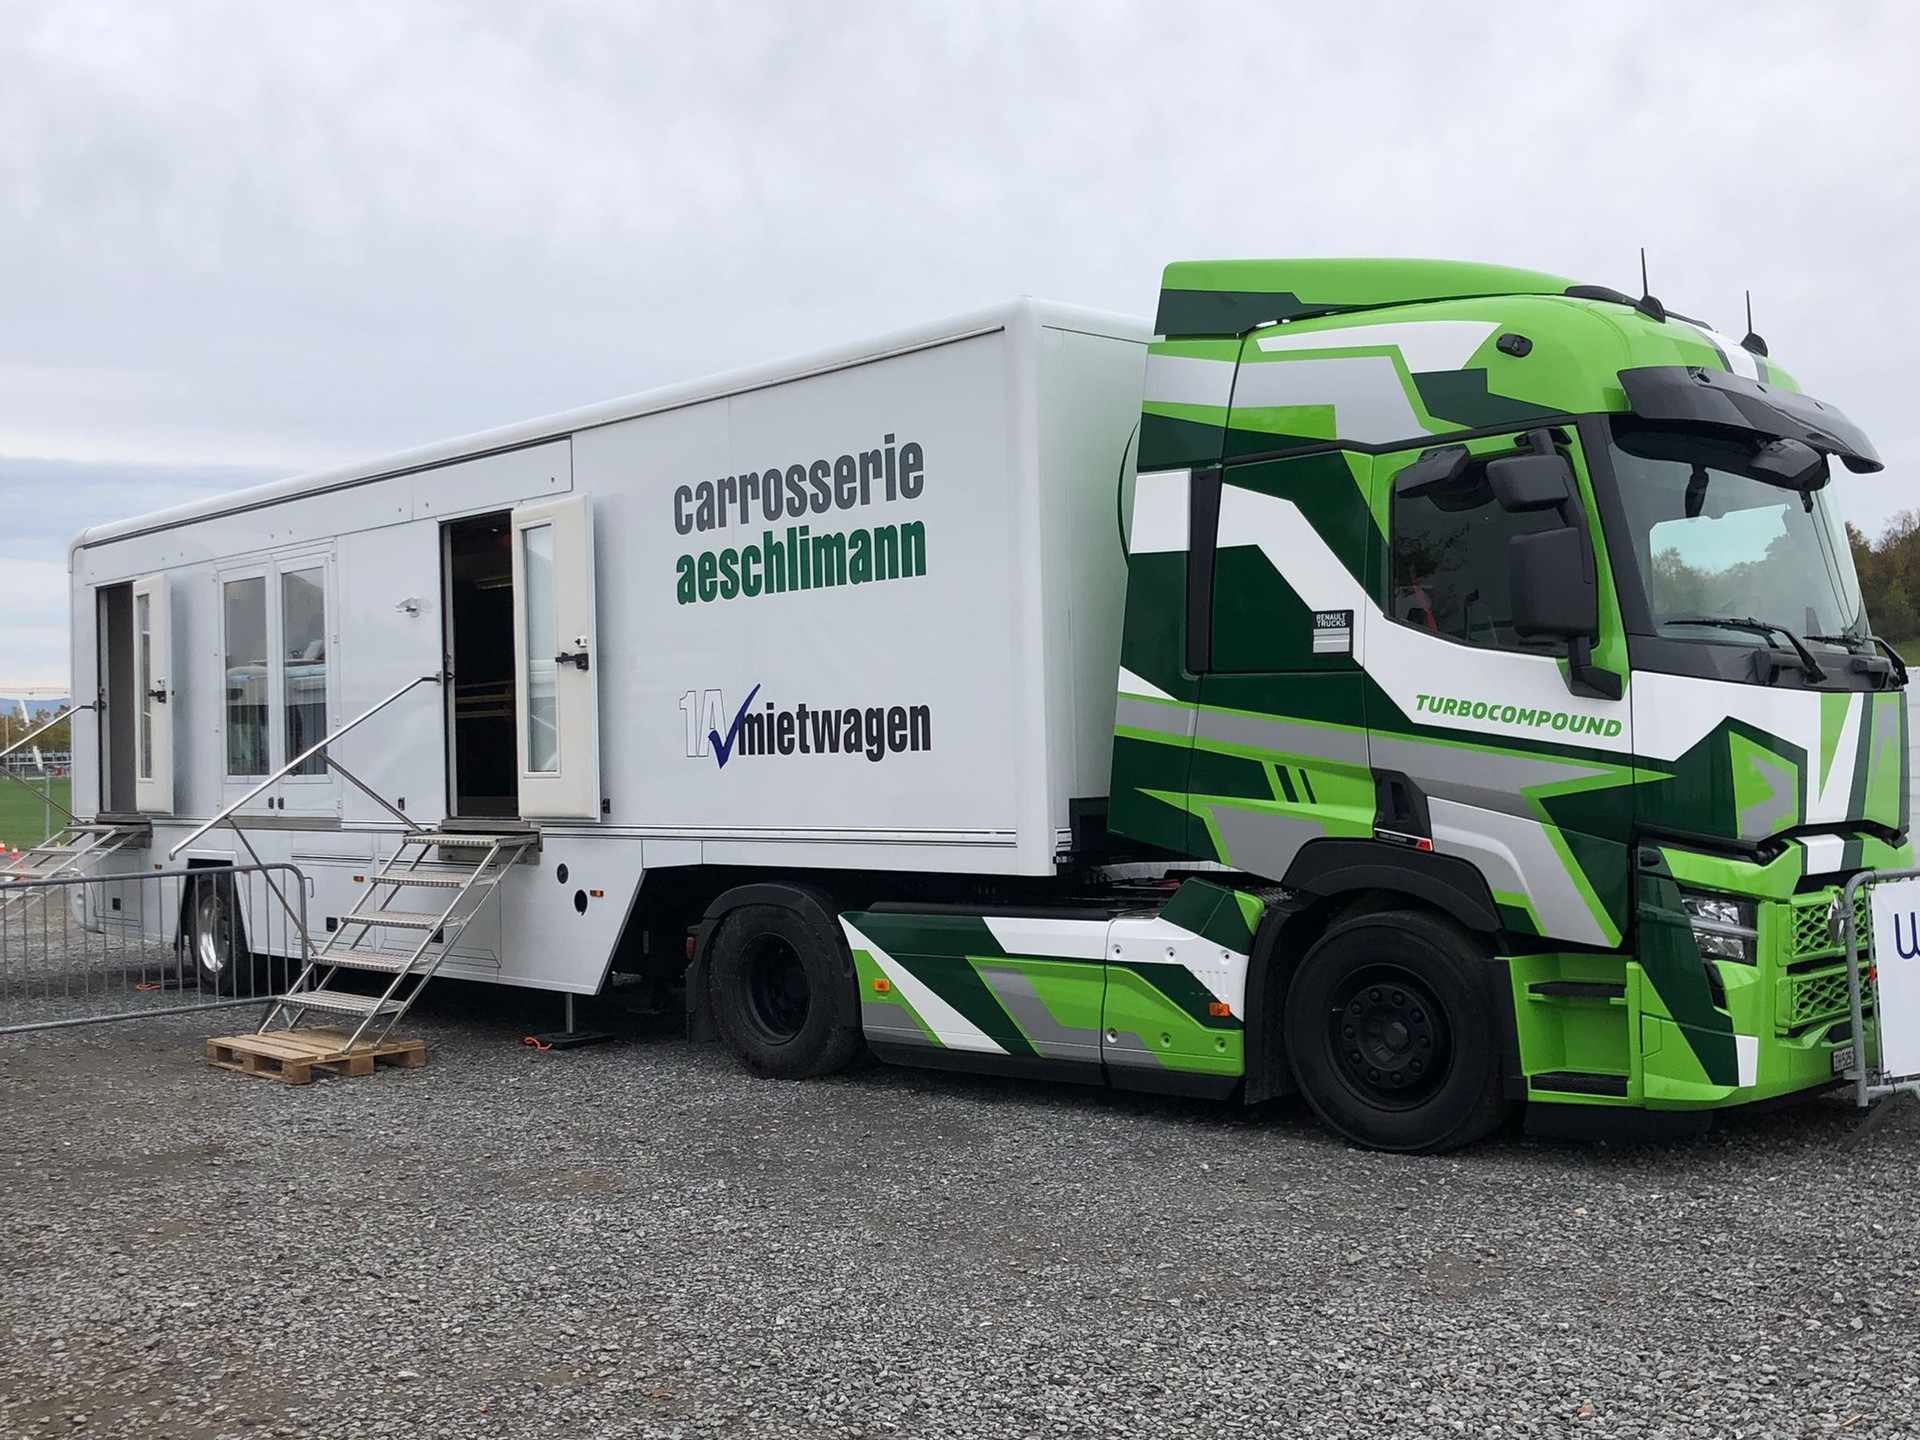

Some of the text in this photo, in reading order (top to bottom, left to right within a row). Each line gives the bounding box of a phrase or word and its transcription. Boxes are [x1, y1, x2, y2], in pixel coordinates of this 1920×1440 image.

[674, 433, 925, 536] carrosserie
[676, 520, 927, 605] aeschlimann
[1316, 613, 1346, 621] RENAULT
[1317, 620, 1346, 628] TRUCKS
[738, 702, 932, 762] mietwagen
[1416, 694, 1623, 737] TURBOCOMPOUND
